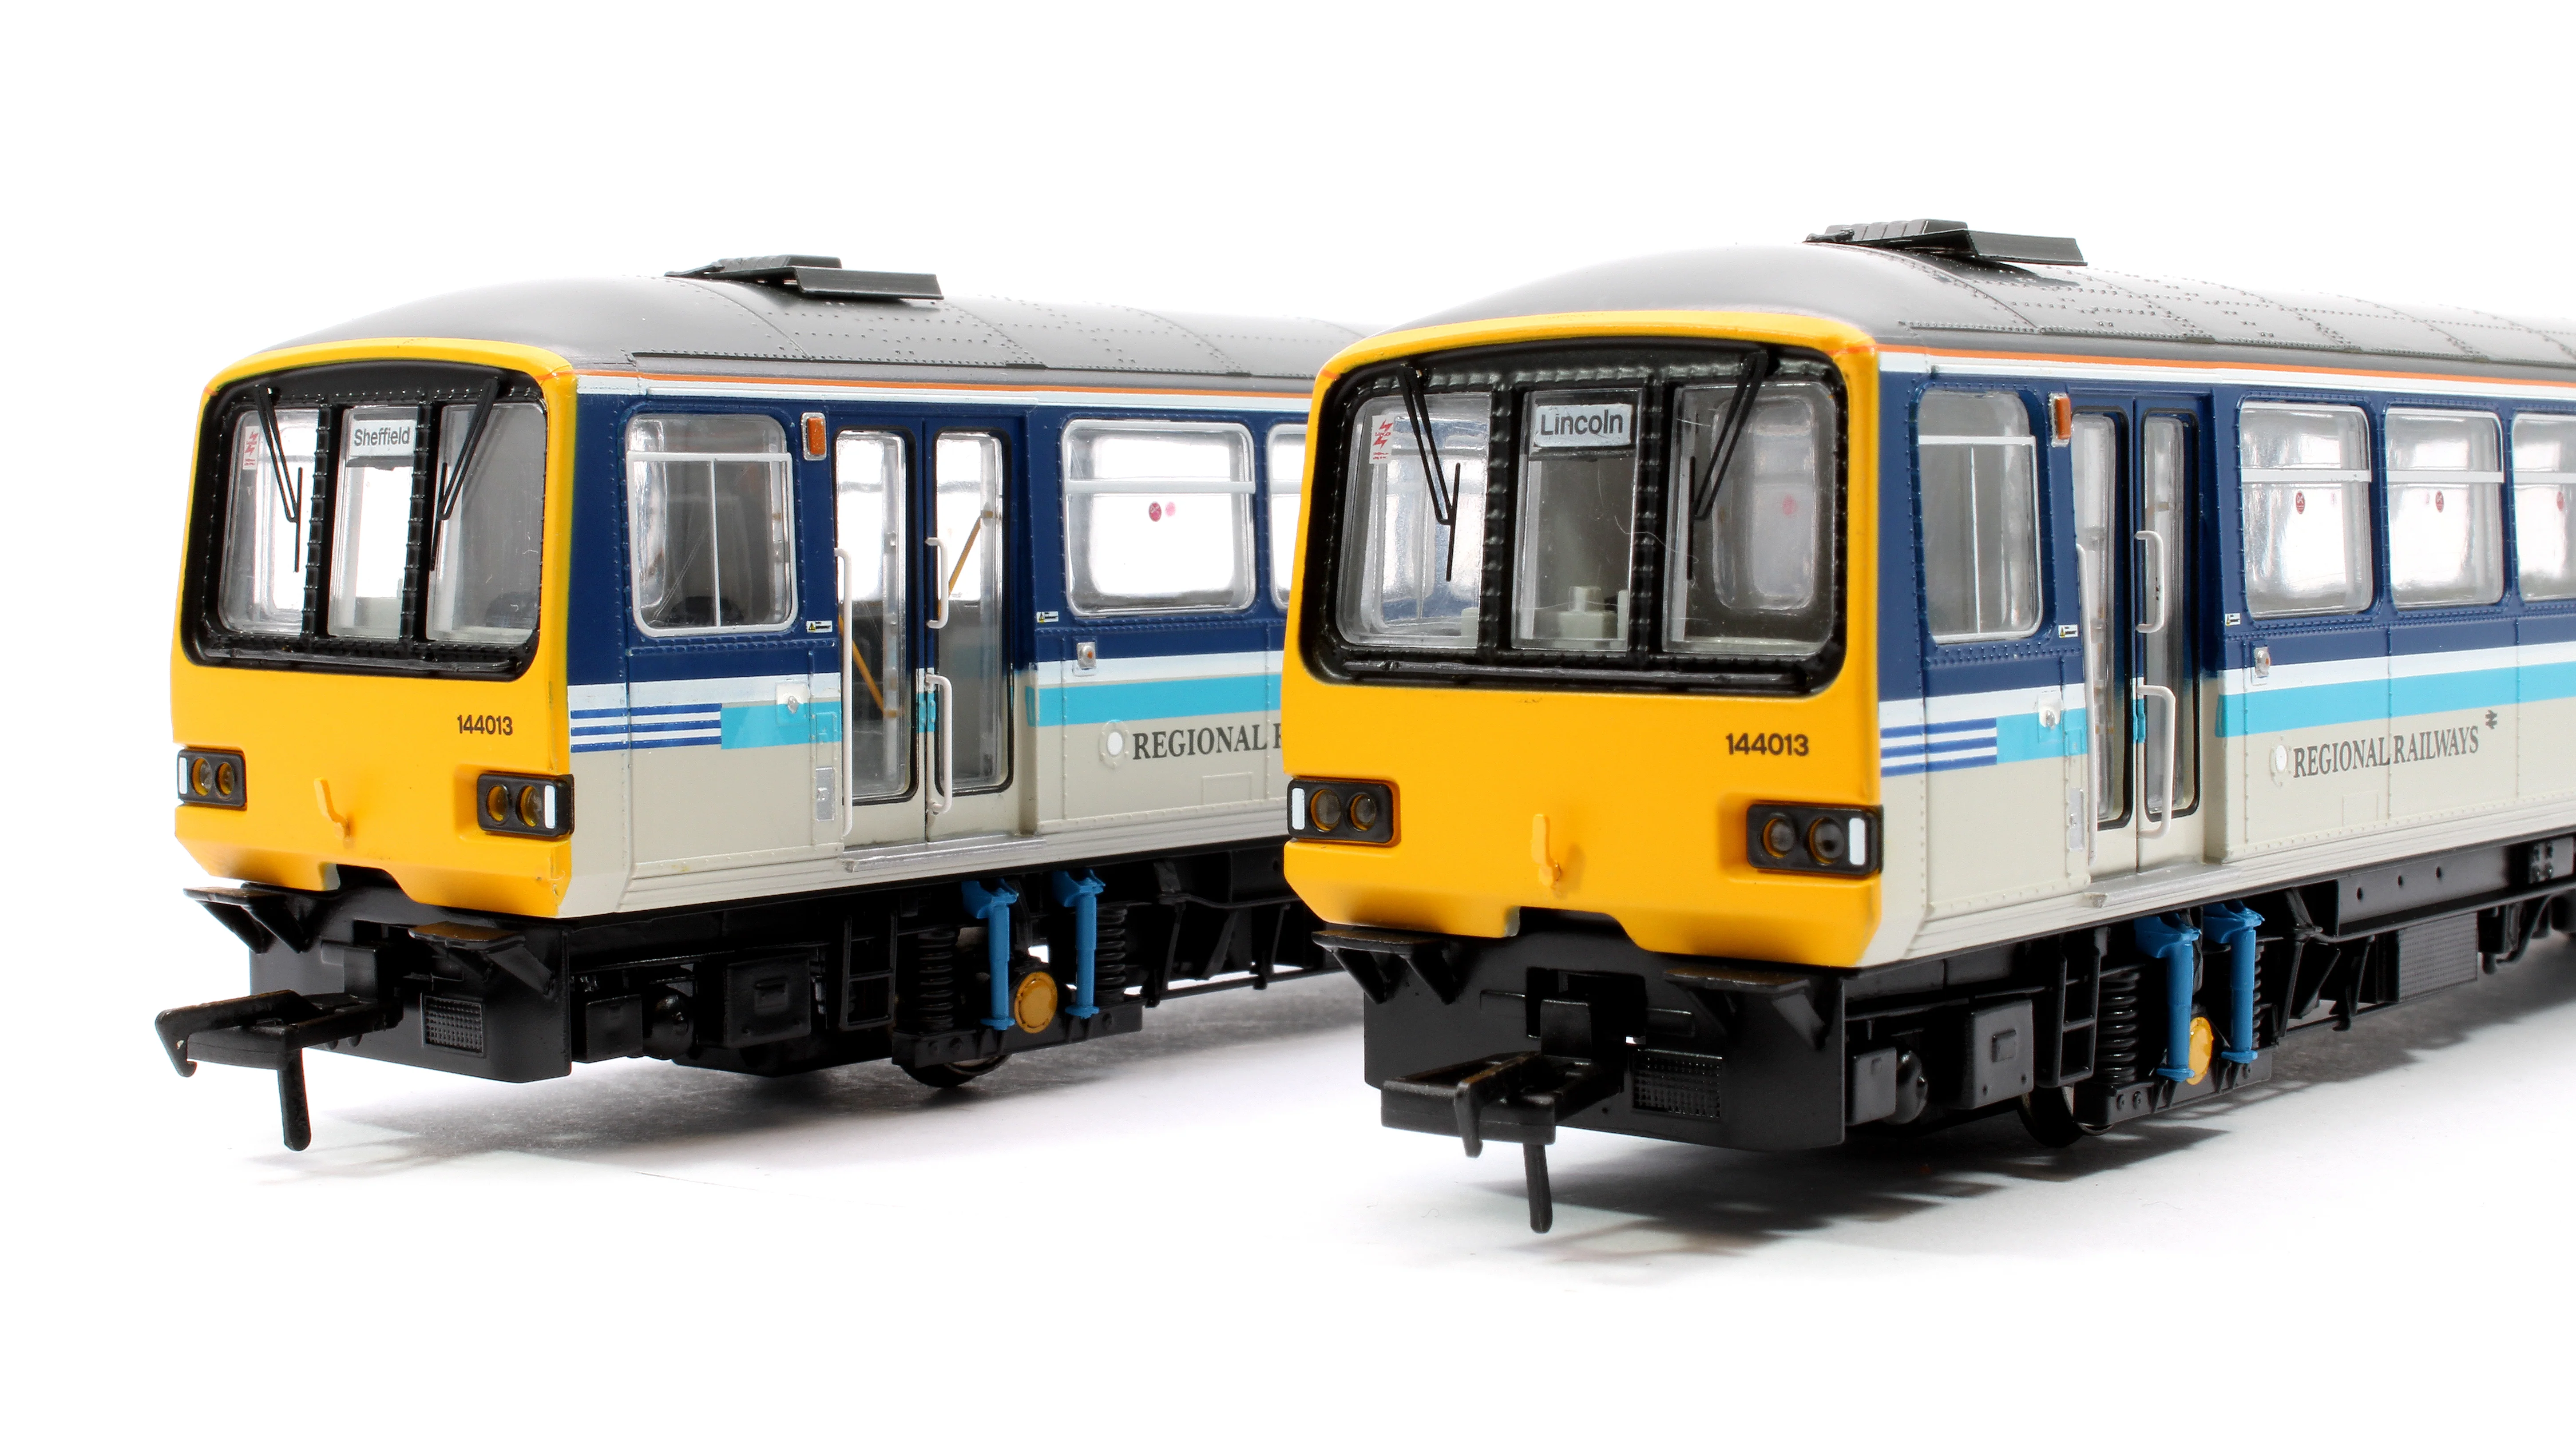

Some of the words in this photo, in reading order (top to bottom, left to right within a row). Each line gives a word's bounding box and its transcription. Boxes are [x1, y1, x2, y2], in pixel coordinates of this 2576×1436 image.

[1541, 409, 1623, 436] Lincoln
[354, 426, 410, 446] Sheffield
[457, 714, 513, 736] 144013
[1133, 724, 1267, 760] REGIONAL
[1726, 733, 1809, 757] 144013
[2293, 737, 2390, 778] REGIONAL
[2393, 726, 2479, 764] RAILWAYS
